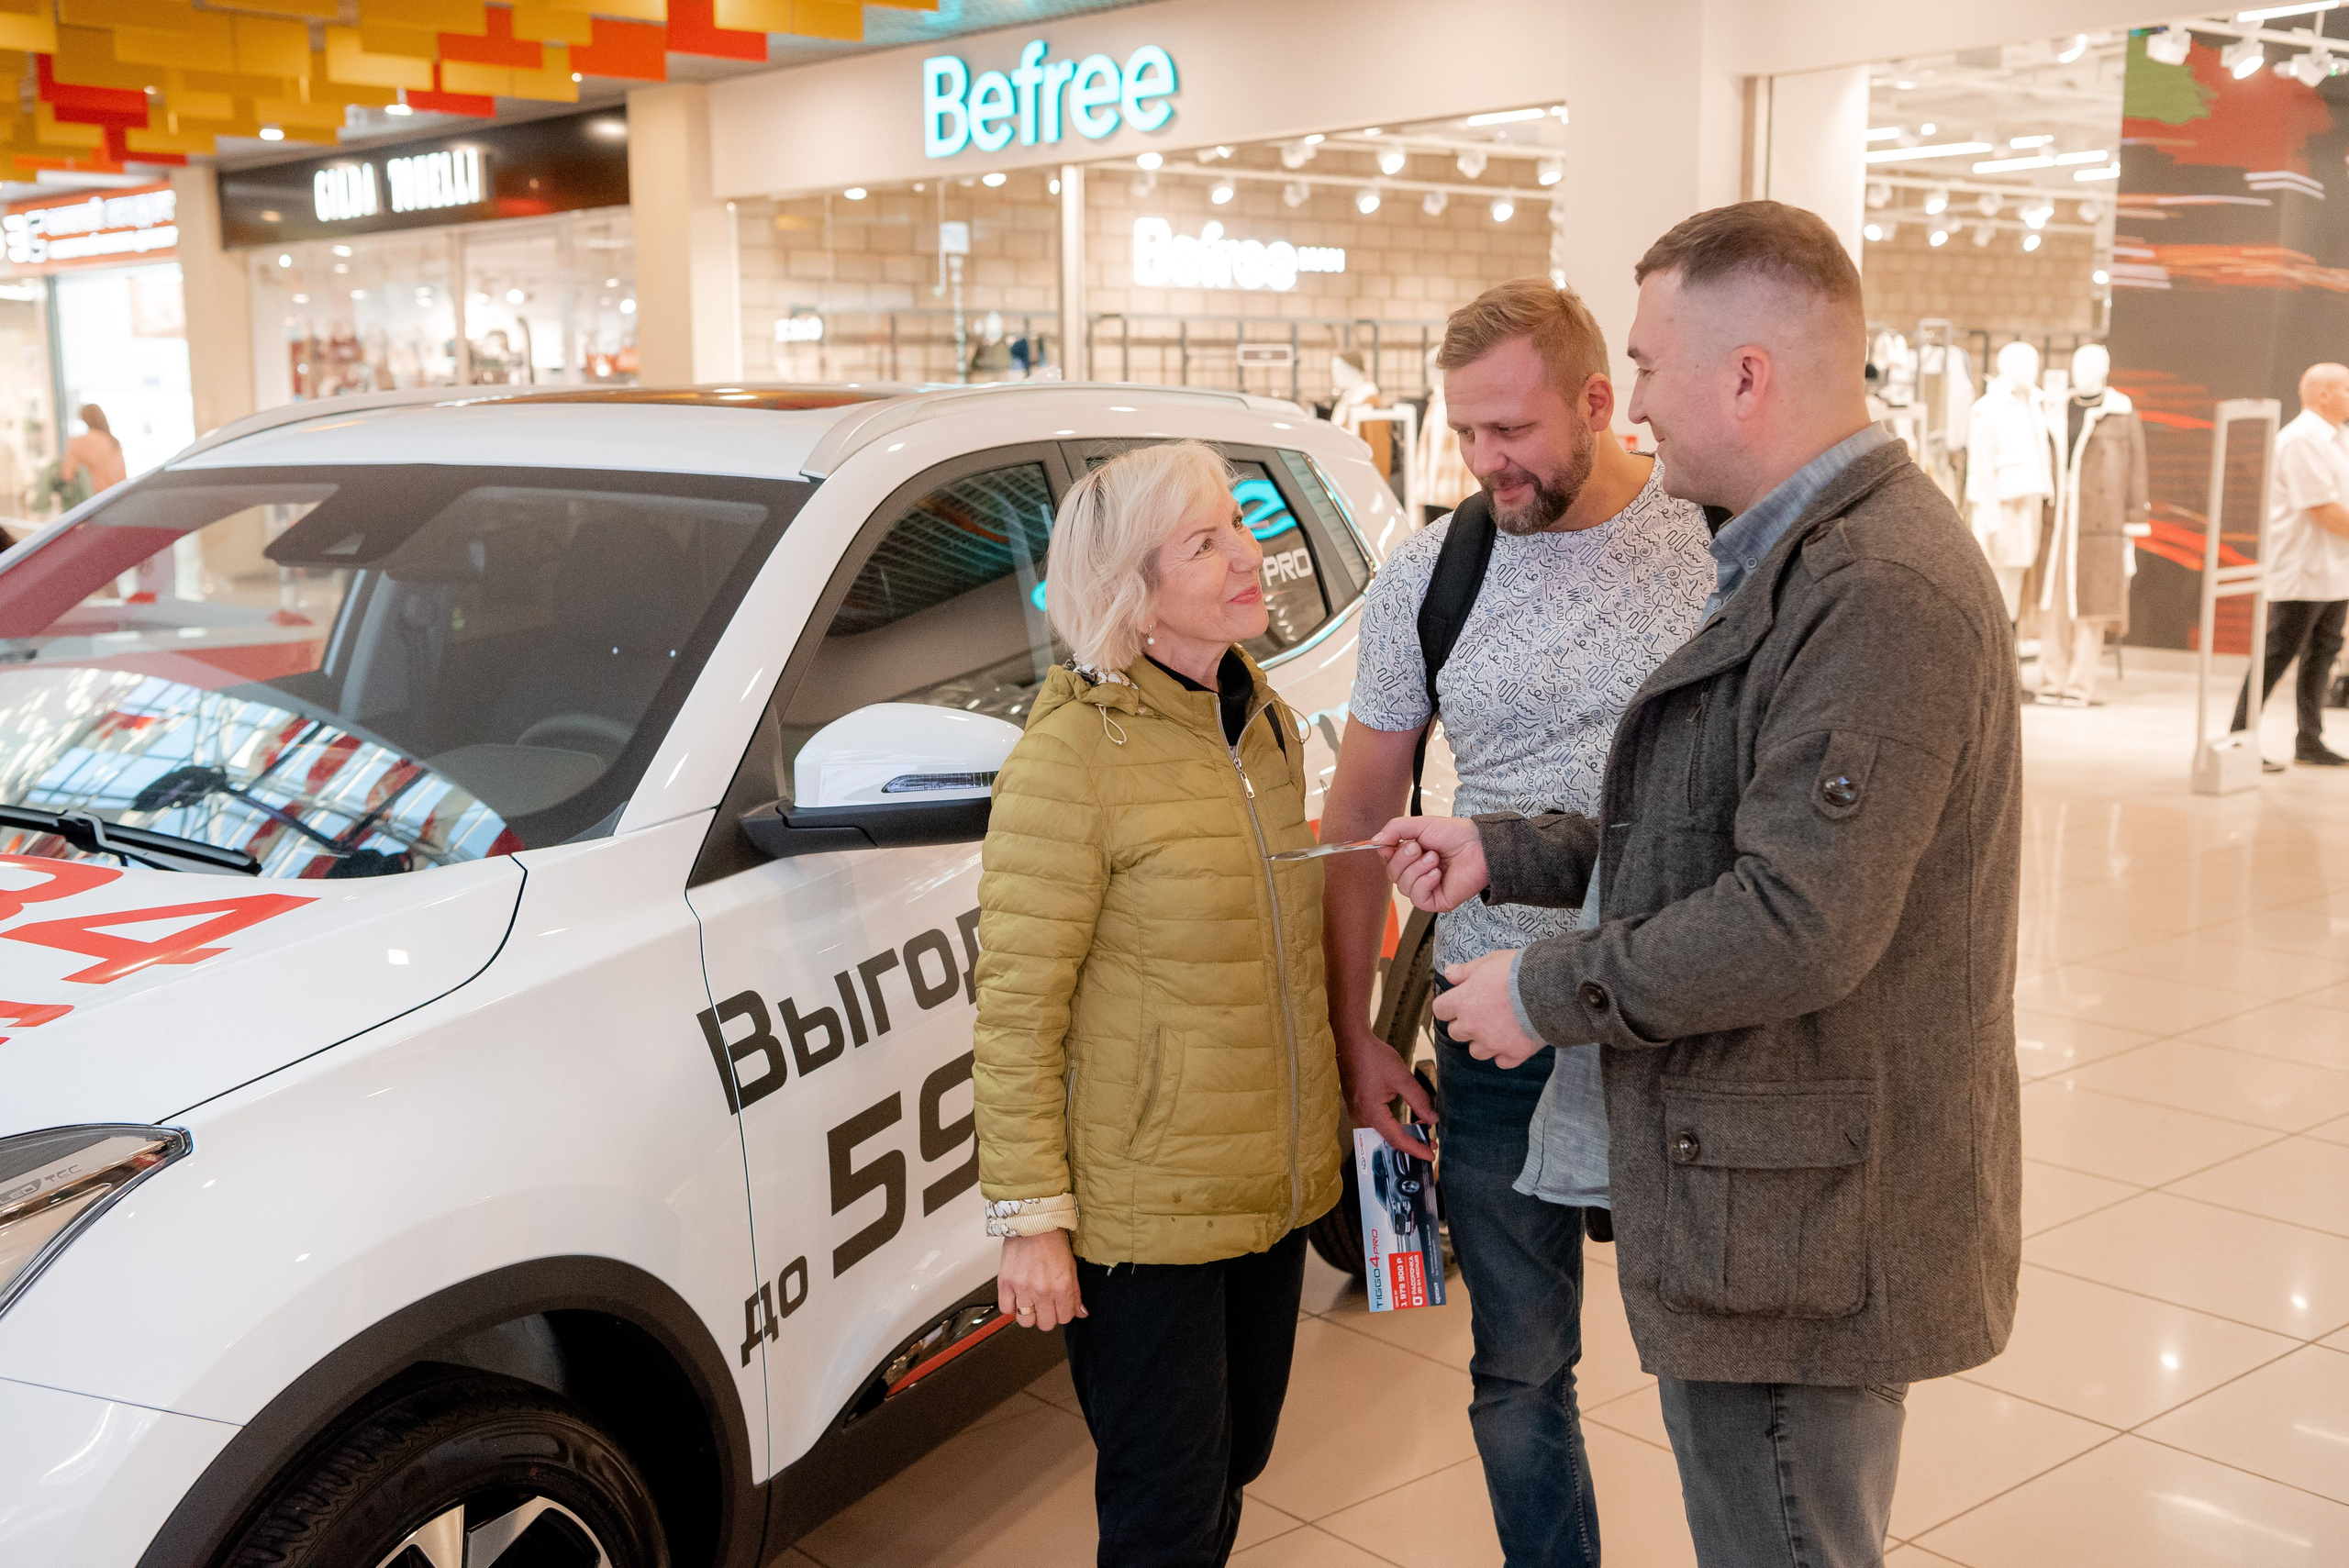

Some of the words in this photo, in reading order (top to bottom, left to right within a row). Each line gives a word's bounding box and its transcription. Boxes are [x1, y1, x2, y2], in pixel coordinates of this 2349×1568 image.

[923, 39, 1177, 159] Befree
[1263, 548, 1313, 586] PRO
[44, 1163, 83, 1183] TEC
[740, 1255, 808, 1368] до
